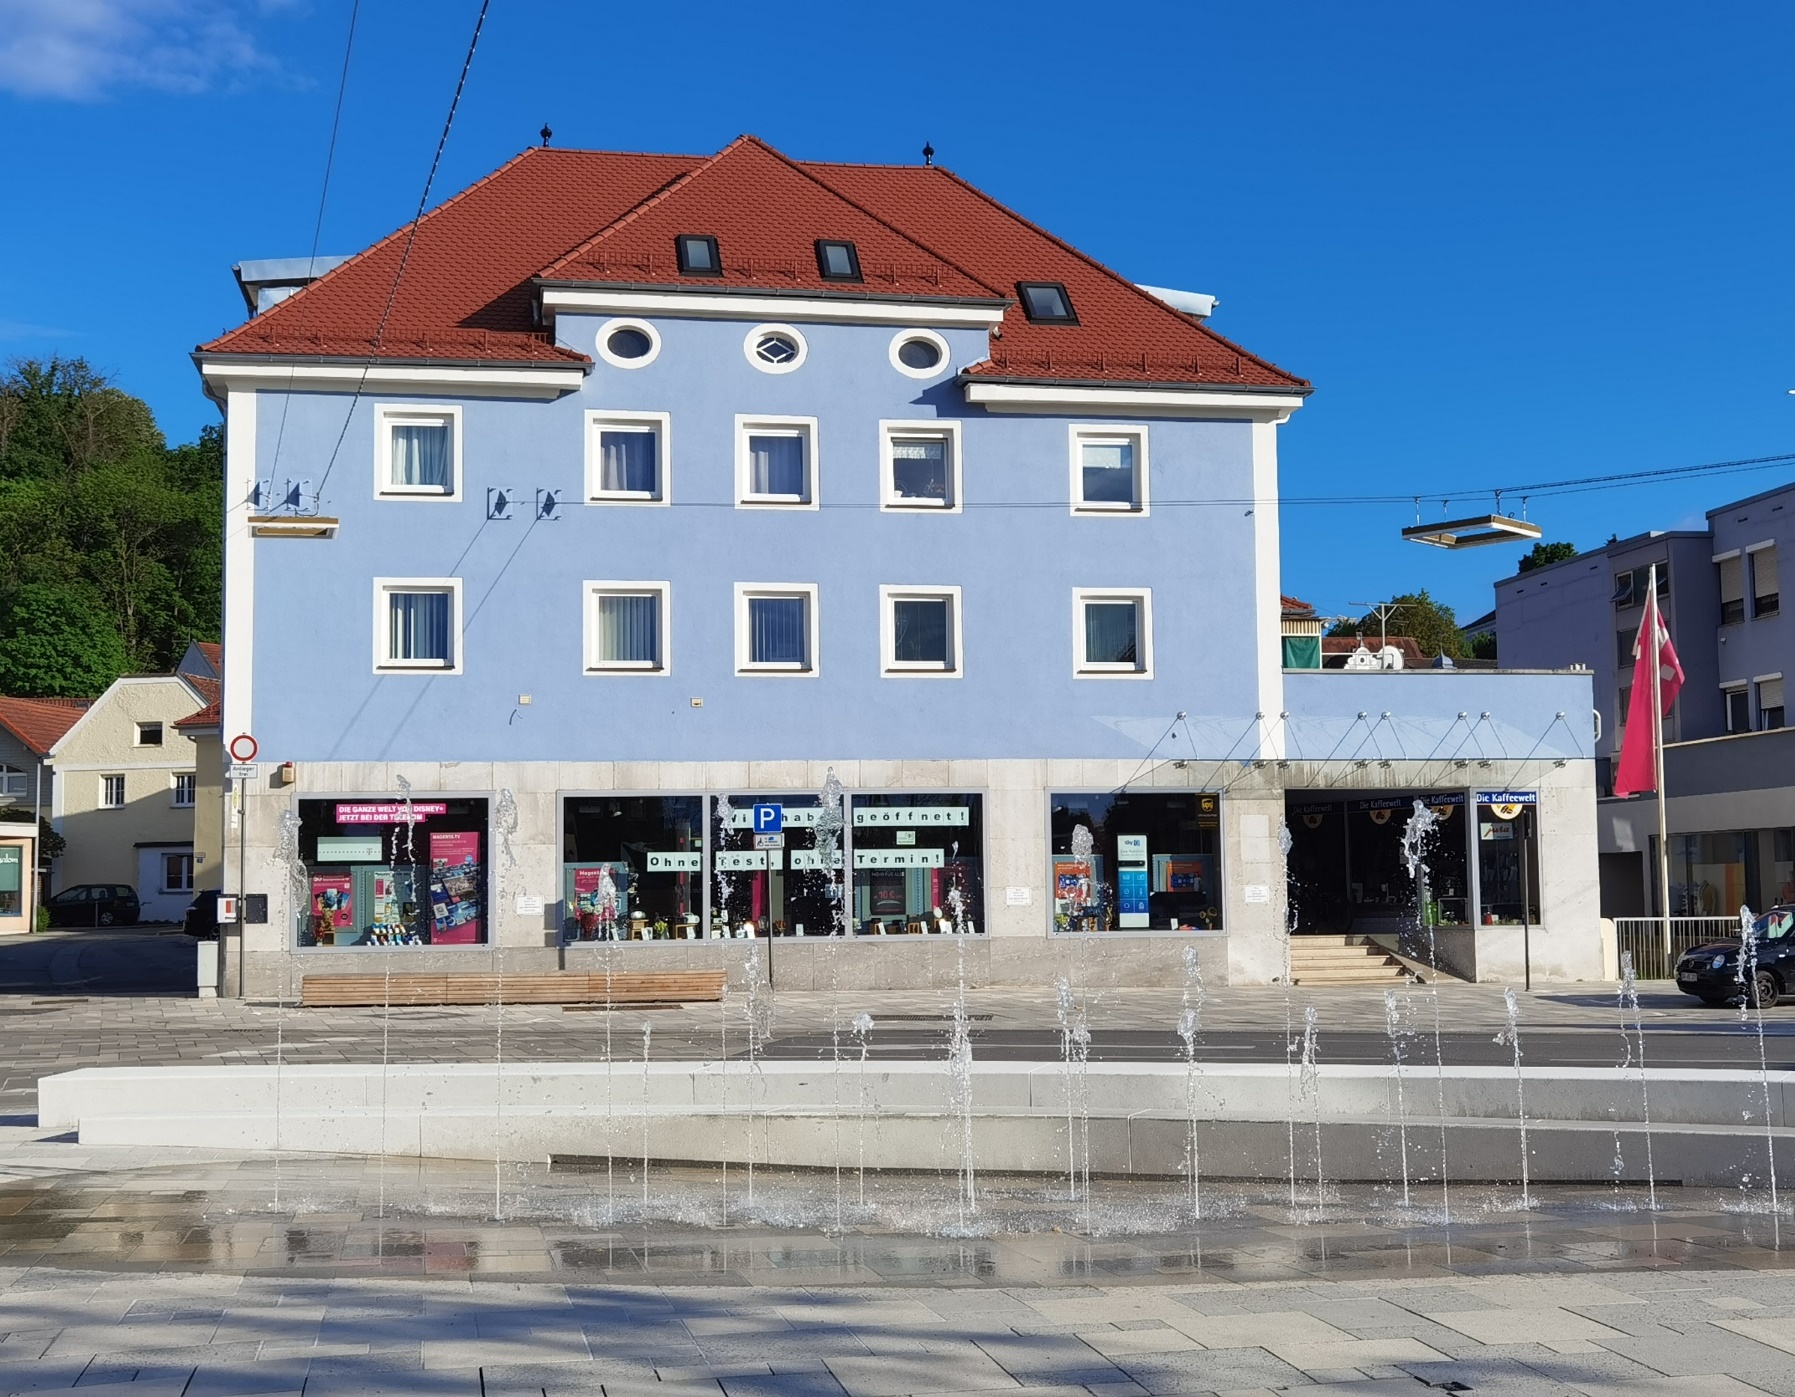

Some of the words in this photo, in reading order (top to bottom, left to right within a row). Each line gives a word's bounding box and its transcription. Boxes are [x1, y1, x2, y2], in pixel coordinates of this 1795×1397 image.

[1431, 794, 1464, 804] Kaffeewelt
[1476, 794, 1490, 802] Die
[1492, 793, 1536, 802] Kaffeewelt
[1304, 805, 1332, 813] Kaffeewelt
[1360, 802, 1369, 810] Die
[1370, 799, 1402, 808] Kaffeewelt
[761, 808, 775, 828] P
[857, 812, 964, 823] geöffnet!
[1484, 824, 1510, 838] jura
[650, 858, 698, 867] Ohne
[719, 857, 774, 866] Test,
[857, 854, 940, 864] Termin!
